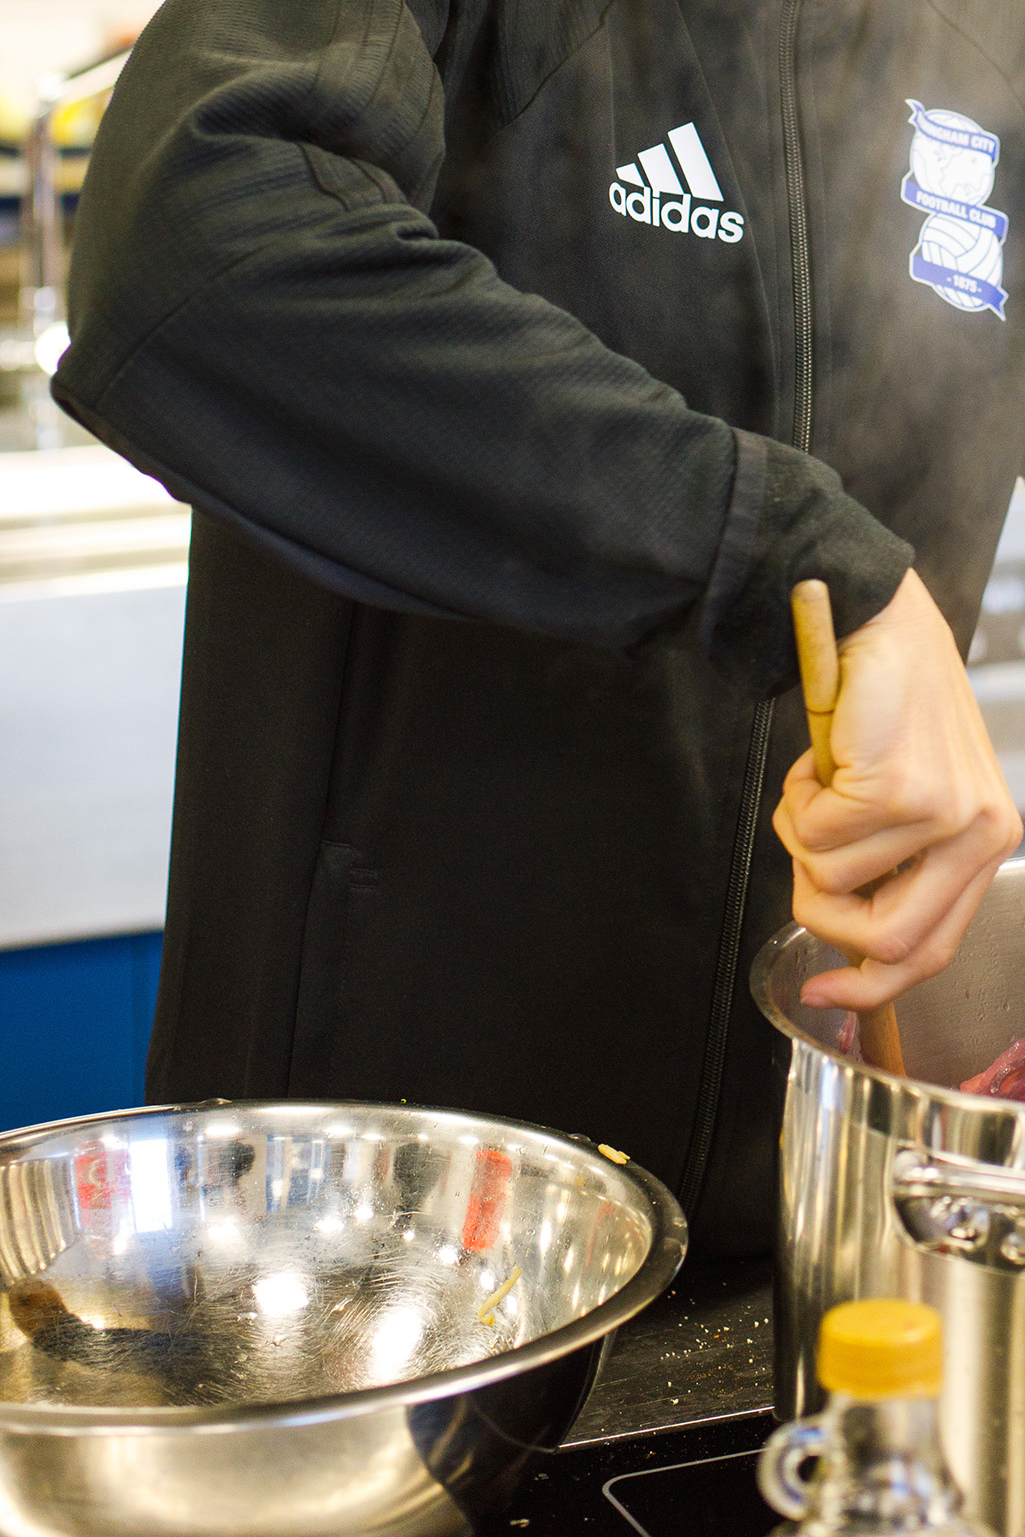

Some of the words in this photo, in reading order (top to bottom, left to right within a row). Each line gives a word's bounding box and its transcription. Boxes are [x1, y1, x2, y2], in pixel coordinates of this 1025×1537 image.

[971, 135, 996, 154] CITY
[609, 181, 745, 244] adidas
[916, 190, 968, 219] FOOTBALL
[969, 208, 997, 229] CLUB
